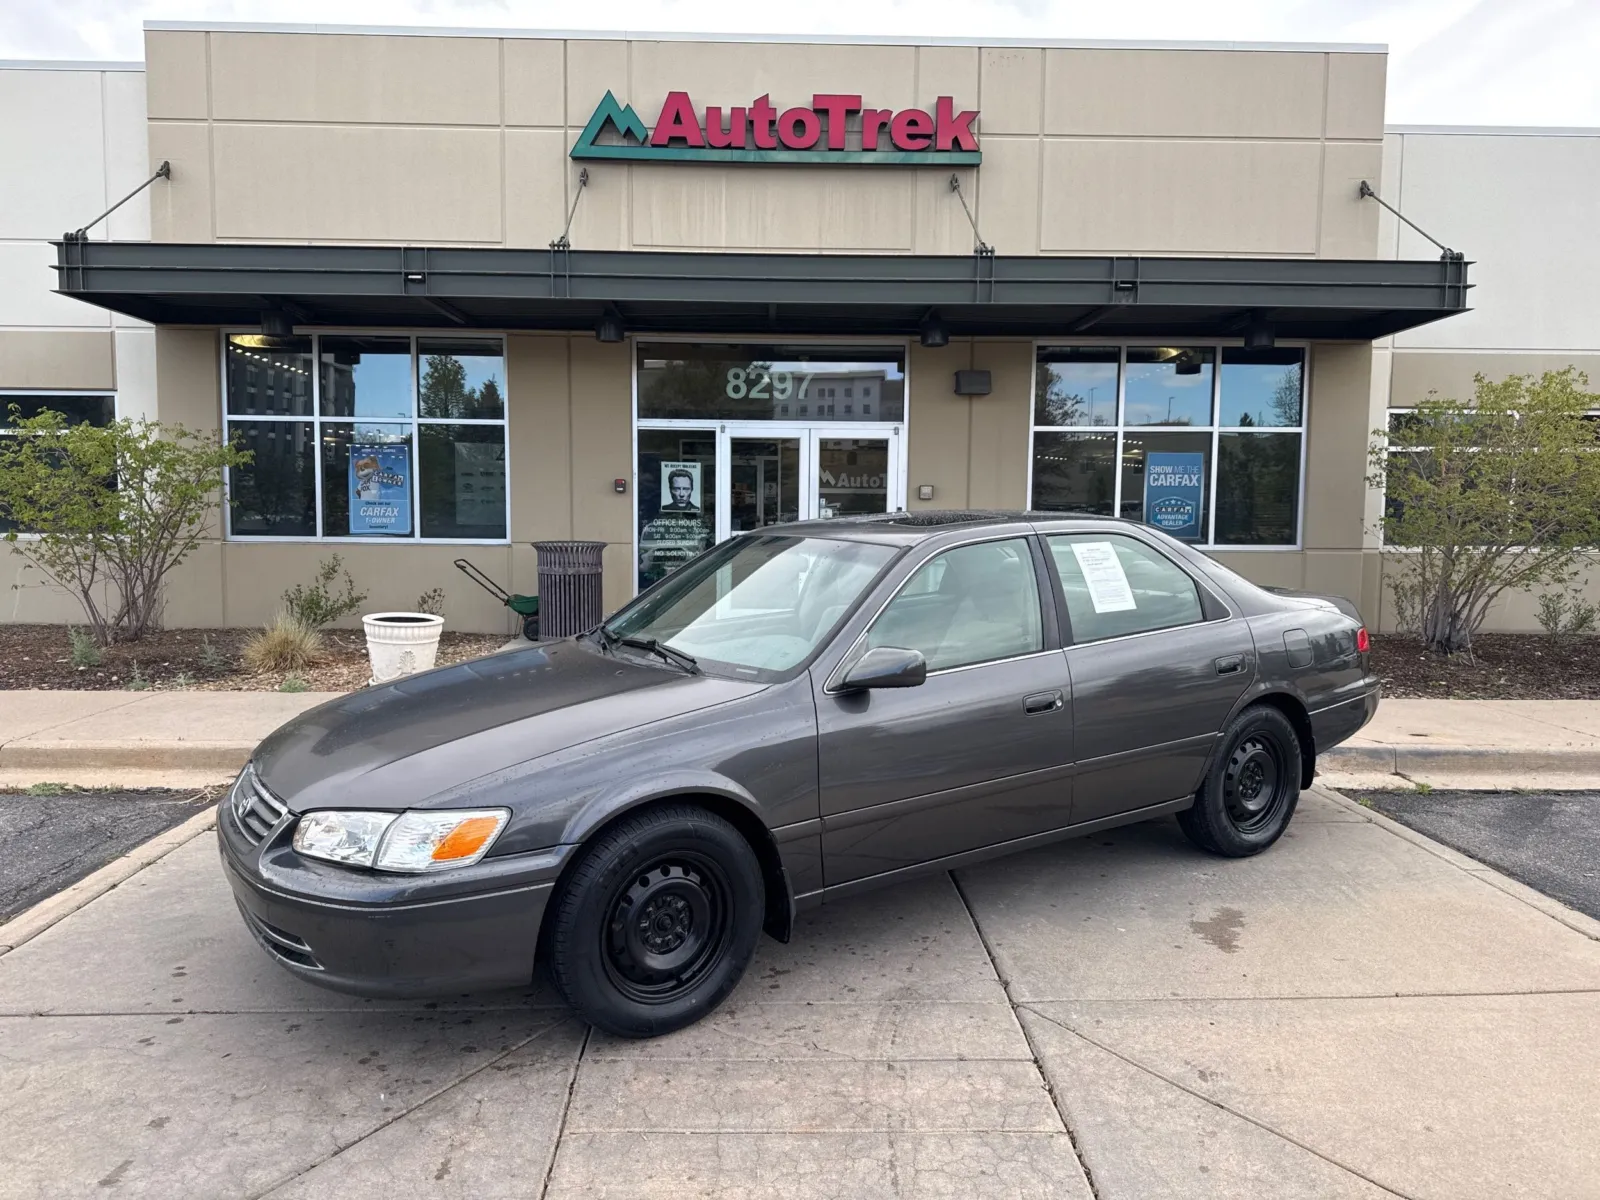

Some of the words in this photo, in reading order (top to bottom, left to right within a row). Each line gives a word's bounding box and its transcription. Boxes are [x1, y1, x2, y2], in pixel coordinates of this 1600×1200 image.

[649, 91, 981, 151] AutoTrek
[726, 367, 815, 400] 8297
[1150, 465, 1173, 474] SHOW
[1174, 465, 1185, 474] ME
[1186, 465, 1200, 474] THE
[1149, 474, 1200, 487] CARFAX
[360, 507, 399, 517] CARFAX
[1155, 506, 1192, 514] CARFAX
[653, 518, 676, 526] OFFICE
[678, 519, 702, 527] HOURS
